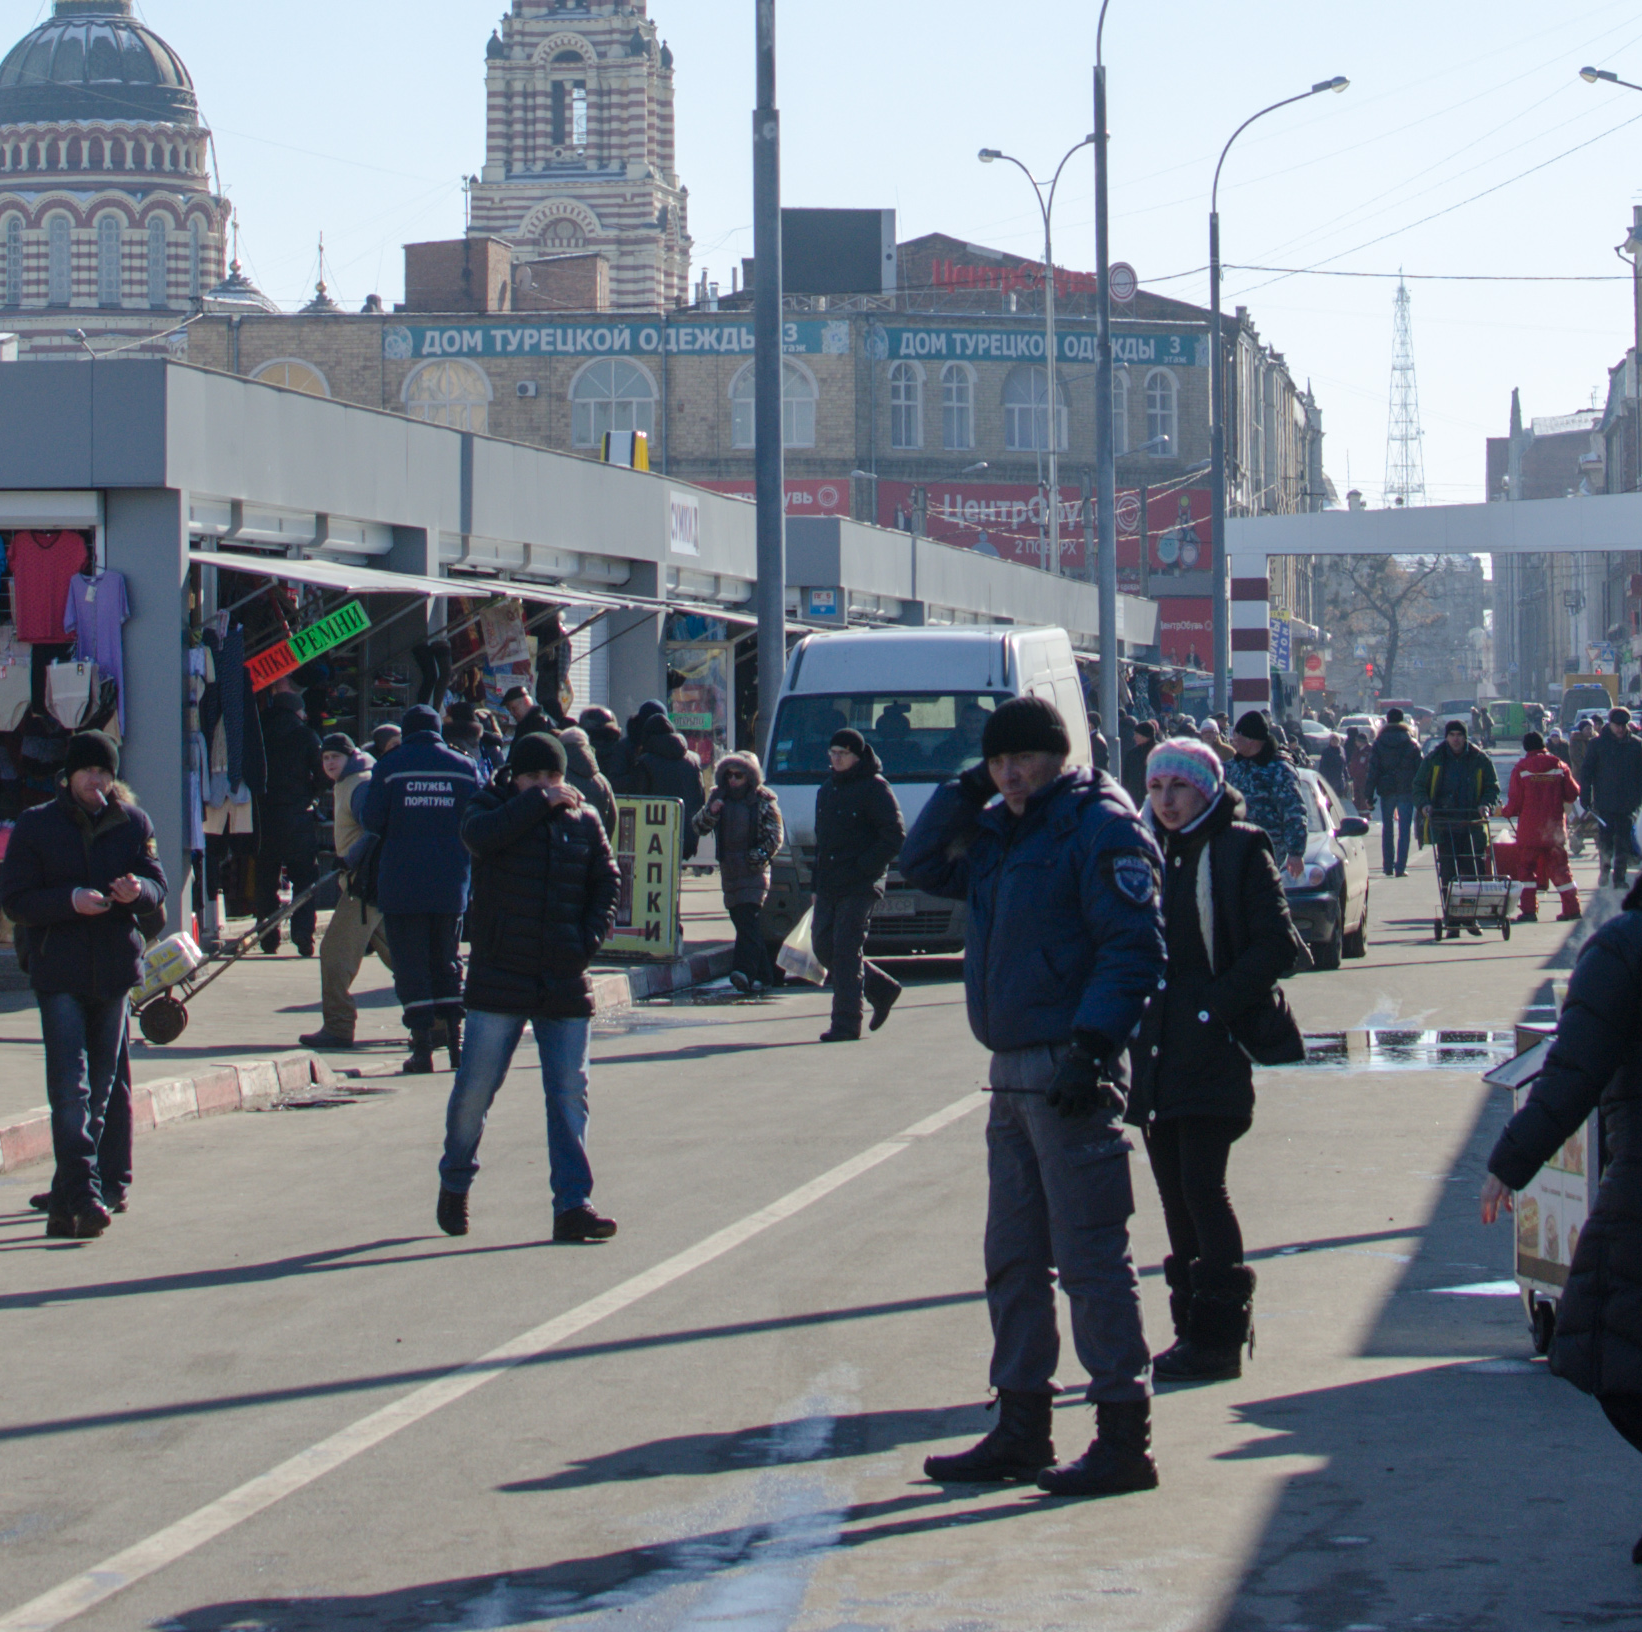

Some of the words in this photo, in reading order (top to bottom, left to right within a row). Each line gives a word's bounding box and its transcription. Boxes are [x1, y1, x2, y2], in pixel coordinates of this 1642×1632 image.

[422, 329, 483, 355] ДОМ
[490, 324, 631, 353] ТУРЕЦКОЙ
[784, 323, 798, 343] 3
[782, 343, 807, 353] таж
[900, 332, 947, 356] ДОМ
[1064, 335, 1155, 361] ОДЖДЫ
[1170, 336, 1181, 354] 3
[1163, 355, 1187, 364] этаж
[1015, 540, 1023, 554] 2
[1026, 540, 1077, 555] ПОРХ
[293, 606, 365, 658] РЕМНИ
[406, 781, 453, 792] СЛУЖБА
[404, 796, 455, 807] ПОРЯТУНКУ
[645, 804, 667, 942] ШАПКИ
